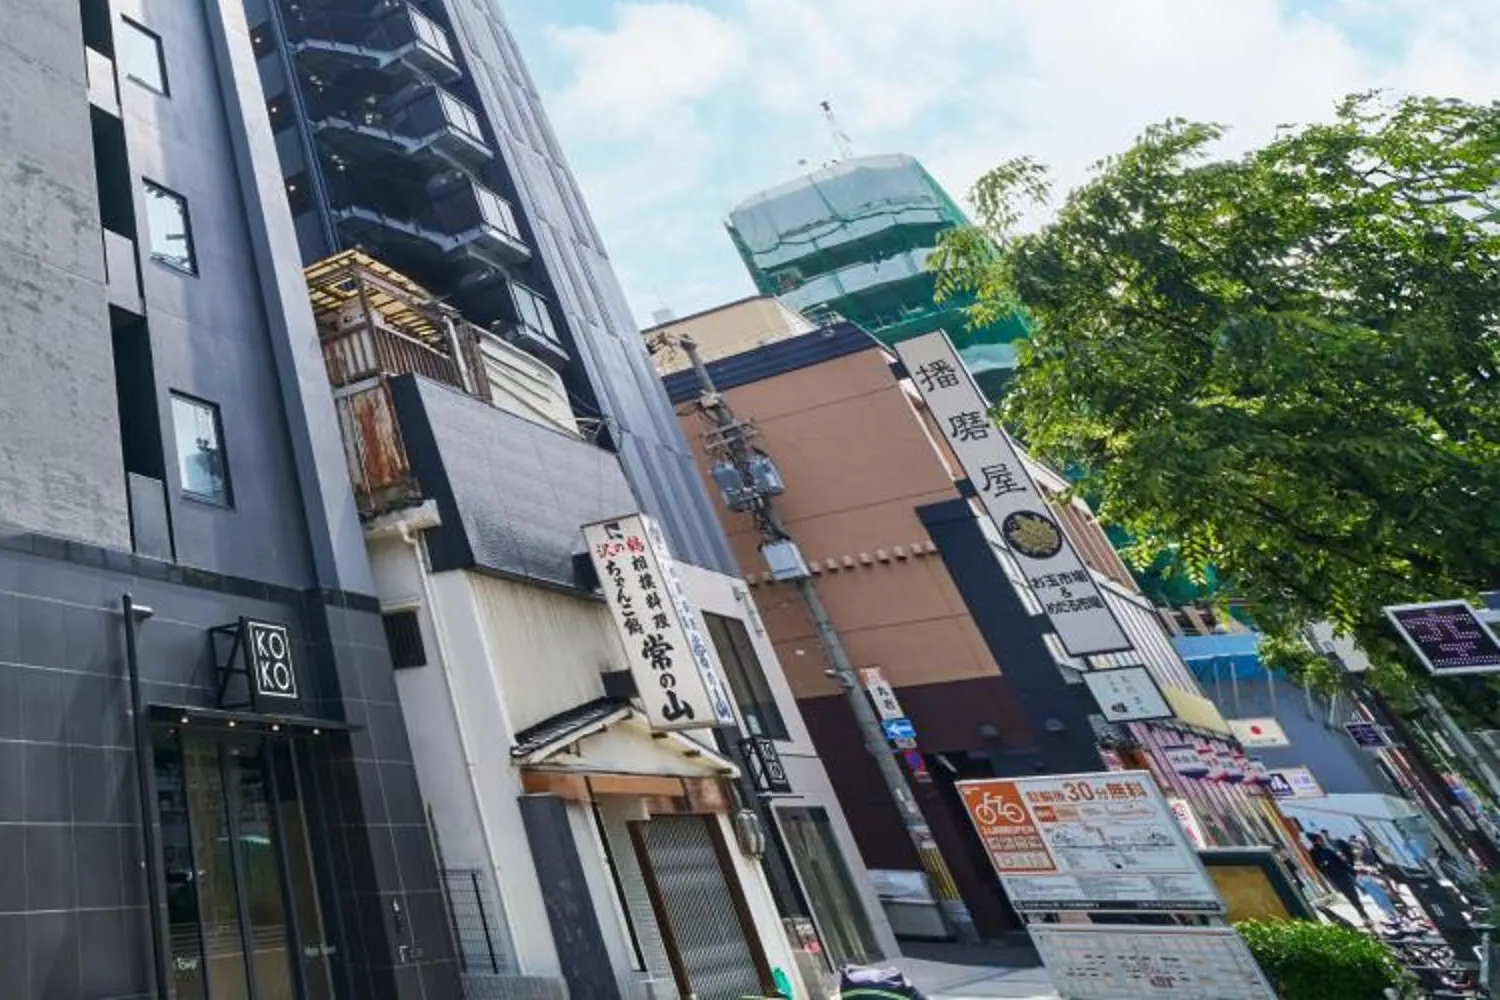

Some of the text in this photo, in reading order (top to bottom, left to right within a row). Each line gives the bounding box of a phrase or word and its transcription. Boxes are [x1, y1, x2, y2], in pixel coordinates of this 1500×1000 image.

[915, 358, 1027, 498] 播磨屋
[605, 559, 645, 636] ちゃんこ鍋
[631, 555, 671, 630] 相撲料理
[255, 629, 285, 660] KO
[260, 661, 290, 690] KO
[642, 633, 695, 722] 常の山
